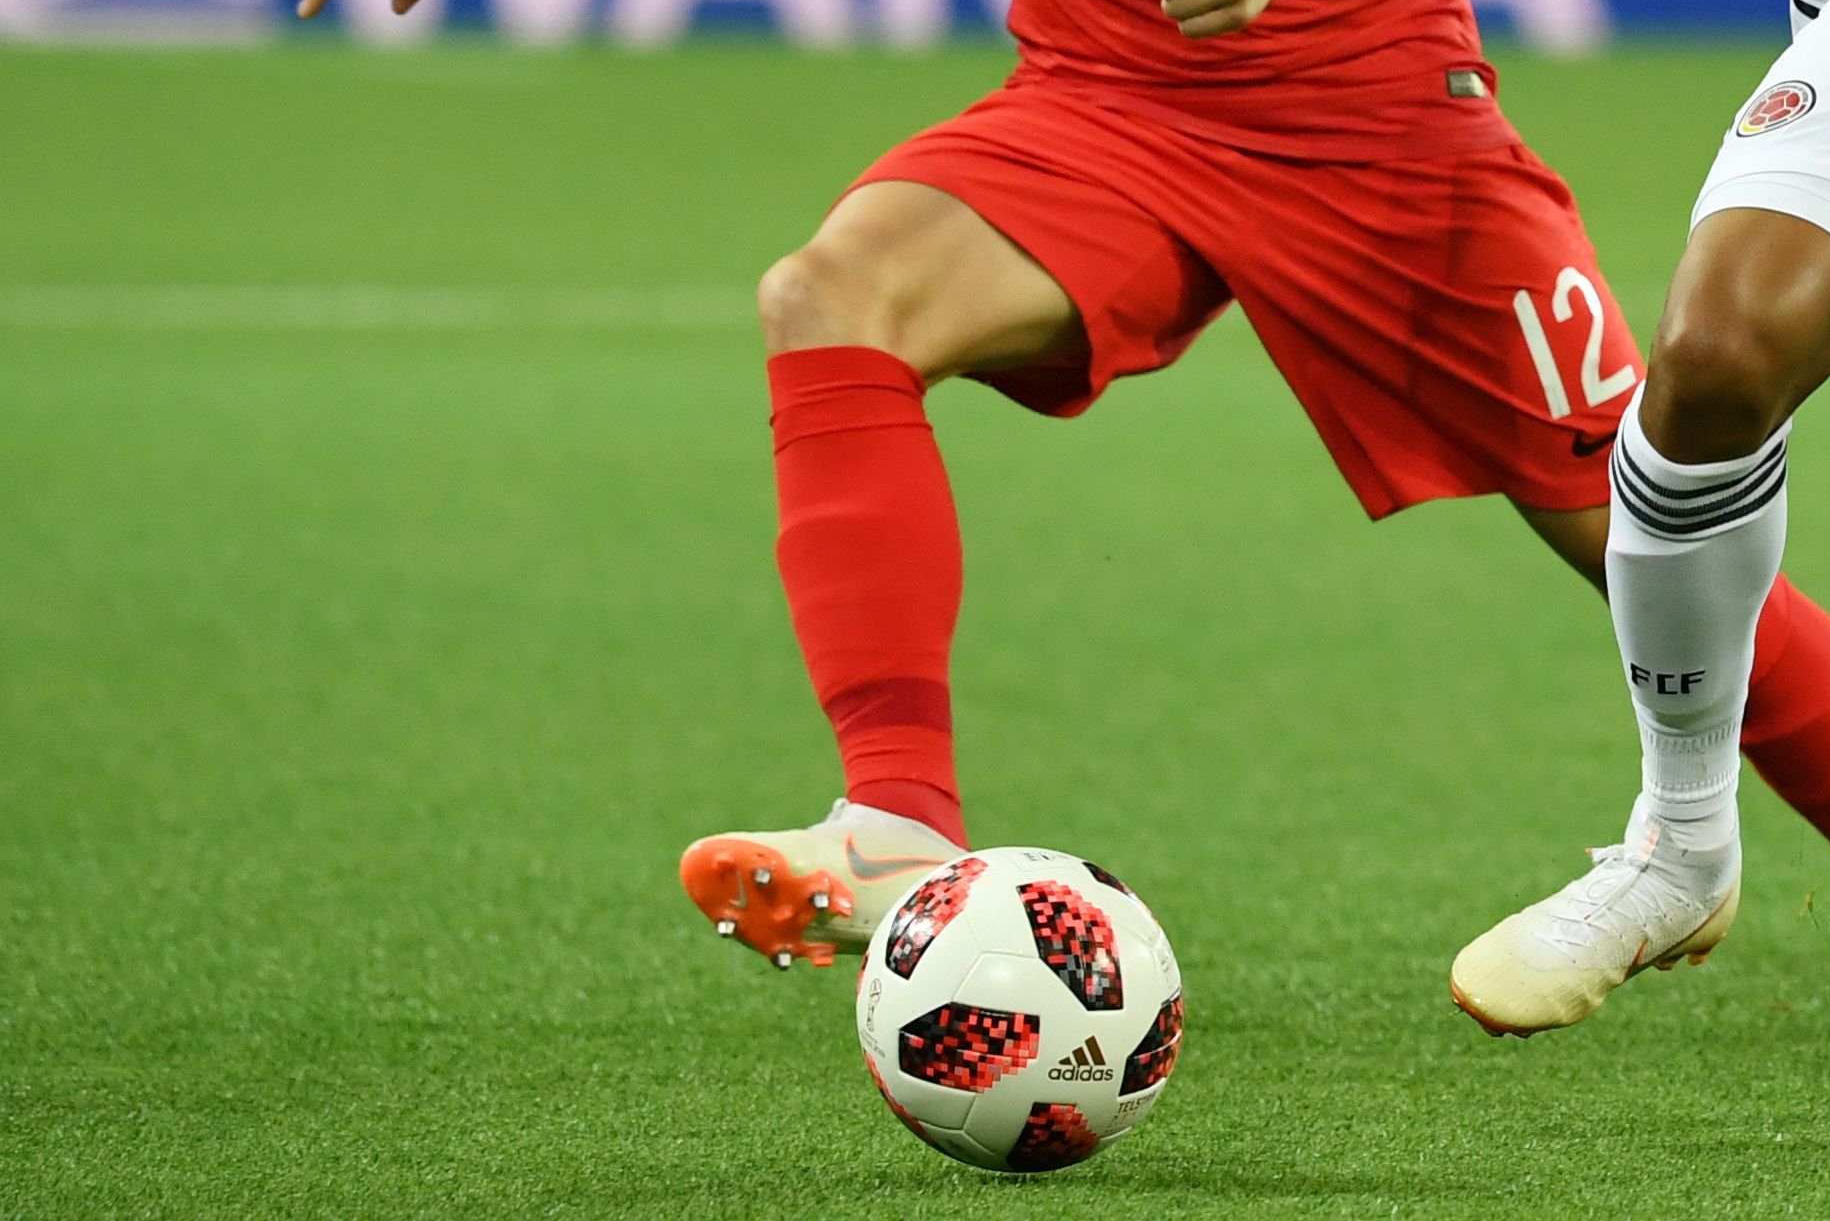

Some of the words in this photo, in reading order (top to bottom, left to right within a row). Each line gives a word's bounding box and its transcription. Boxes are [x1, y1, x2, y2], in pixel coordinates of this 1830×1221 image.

[1512, 265, 1637, 421] 12
[1630, 662, 1706, 695] FCF
[1047, 1064, 1115, 1082] adidas
